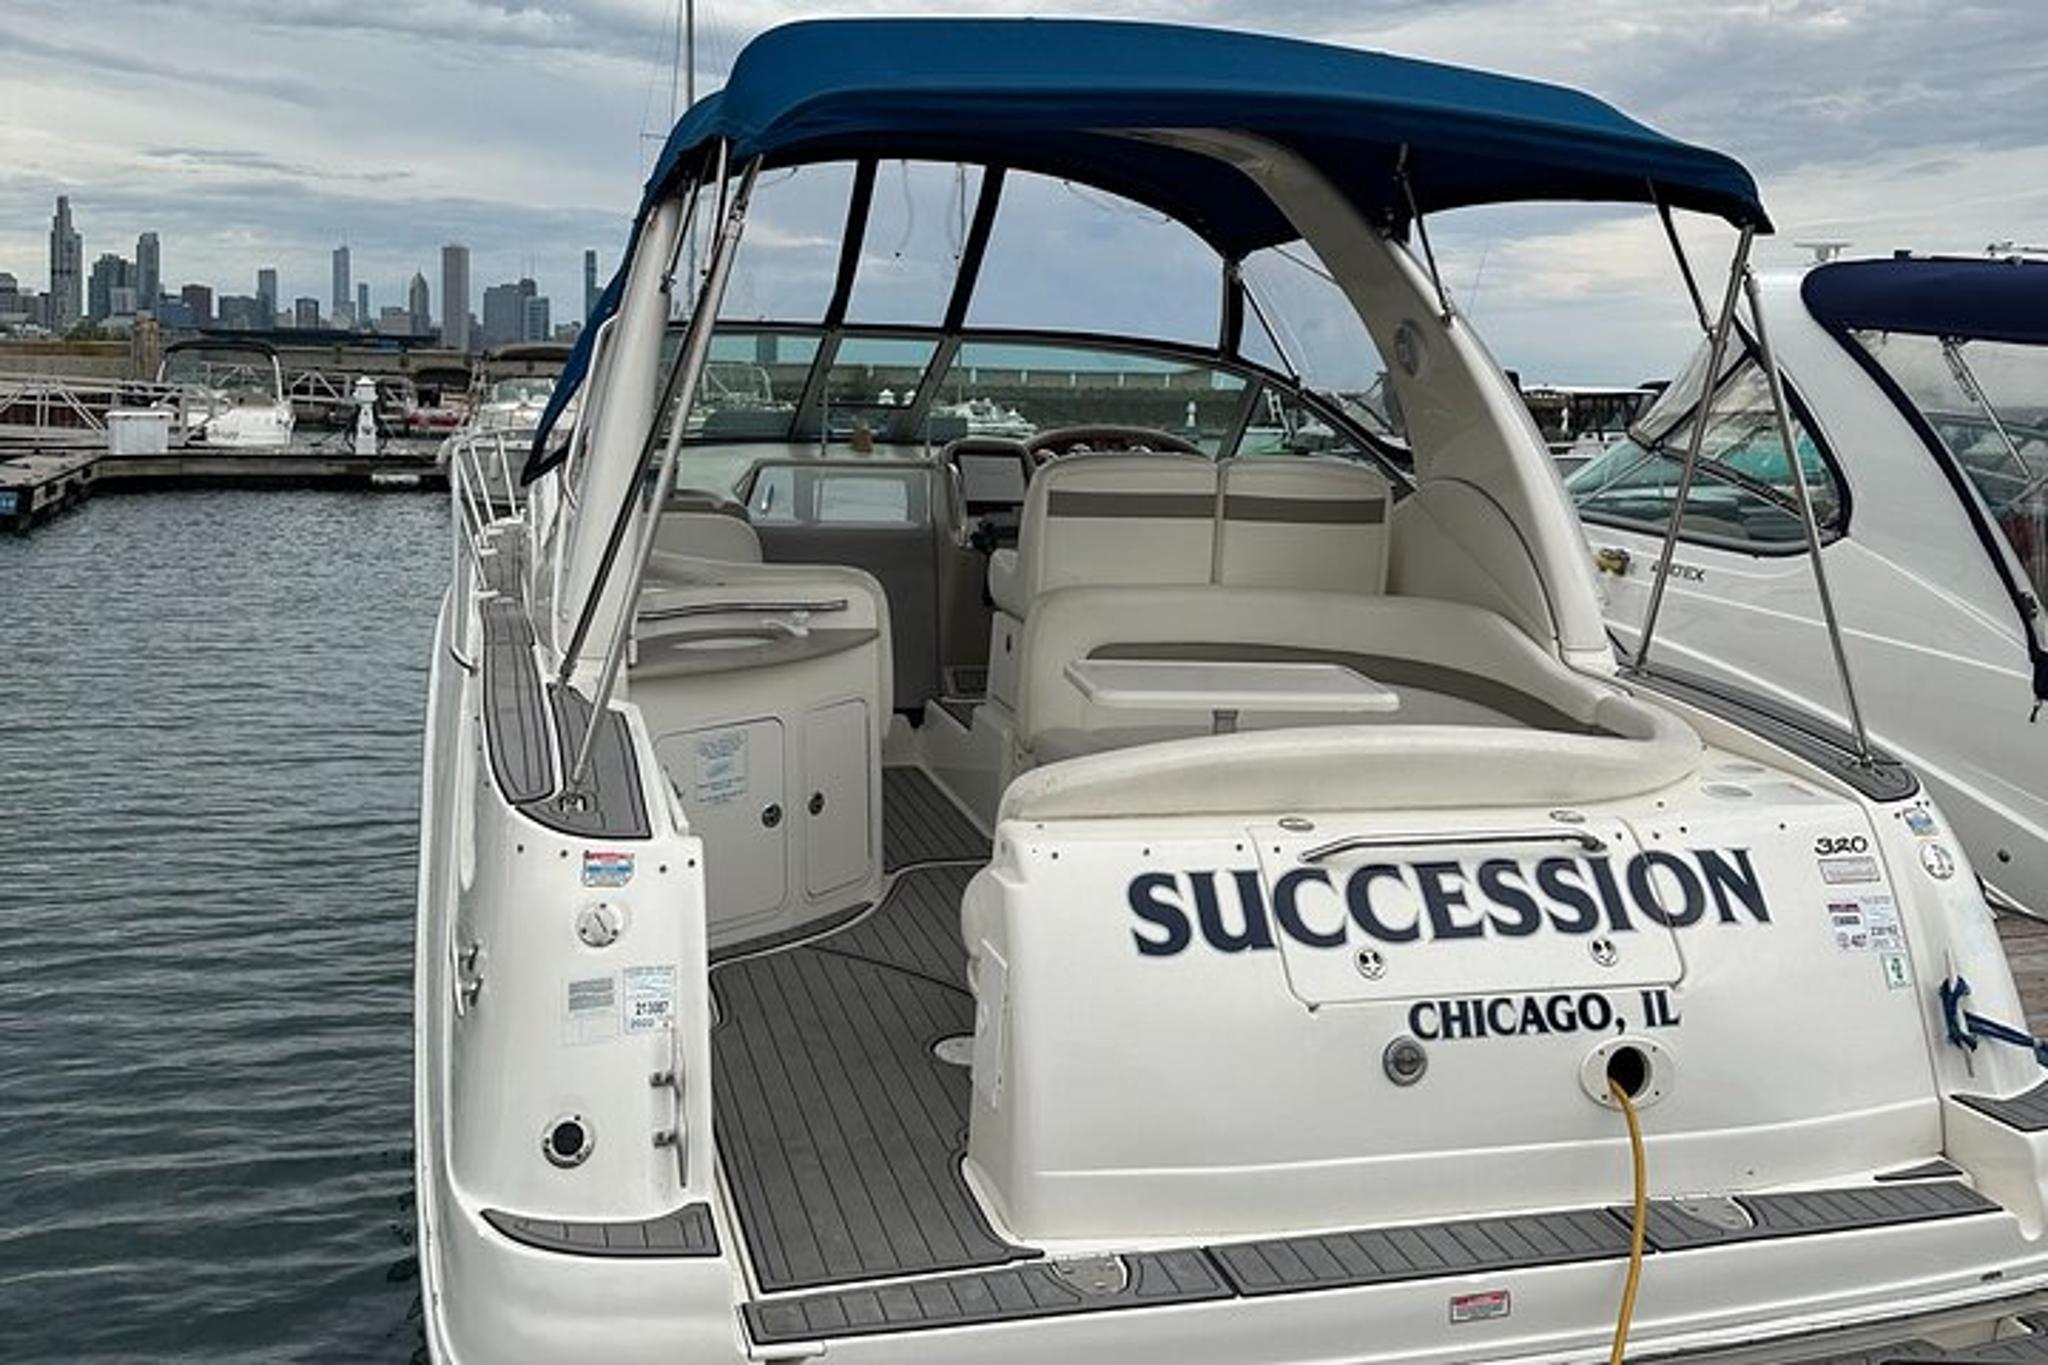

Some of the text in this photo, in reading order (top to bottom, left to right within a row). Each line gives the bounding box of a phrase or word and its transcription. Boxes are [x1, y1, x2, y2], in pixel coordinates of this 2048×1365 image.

[1814, 836, 1868, 856] 320
[1127, 848, 1771, 957] SUCCESSION
[1408, 989, 1681, 1040] CHICAGO, IL
